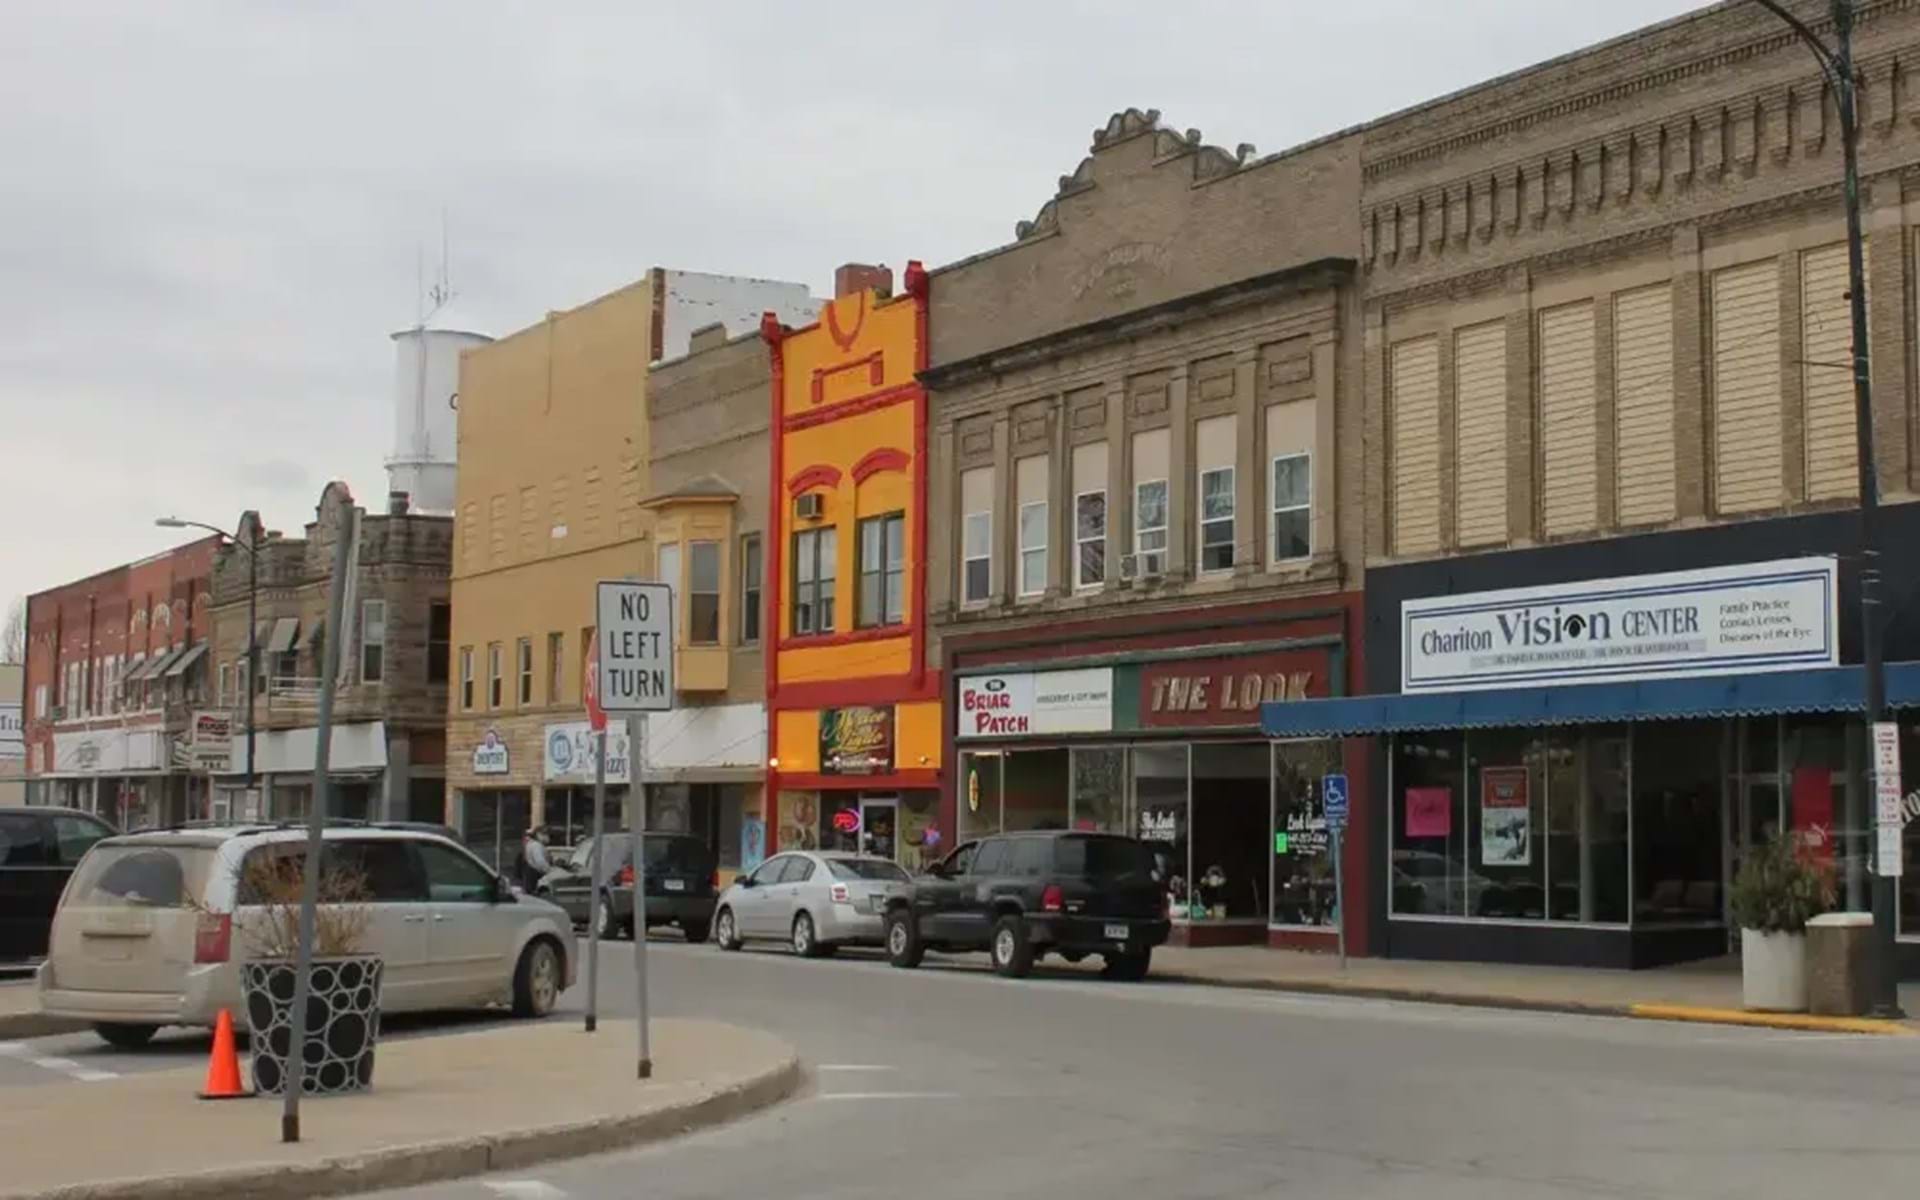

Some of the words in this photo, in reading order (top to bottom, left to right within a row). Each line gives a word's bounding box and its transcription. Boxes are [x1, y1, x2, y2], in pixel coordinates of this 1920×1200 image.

[621, 593, 649, 621] NO
[1752, 600, 1790, 611] Practice
[610, 631, 660, 659] LEFT
[1421, 626, 1492, 656] Chariton
[1496, 606, 1611, 646] Vision
[1622, 606, 1699, 638] CENTER
[608, 668, 665, 697] TURN
[1151, 676, 1211, 711] THE
[1220, 671, 1312, 711] LOOK
[963, 689, 1011, 711] BRIAR
[976, 712, 1028, 733] PATCH
